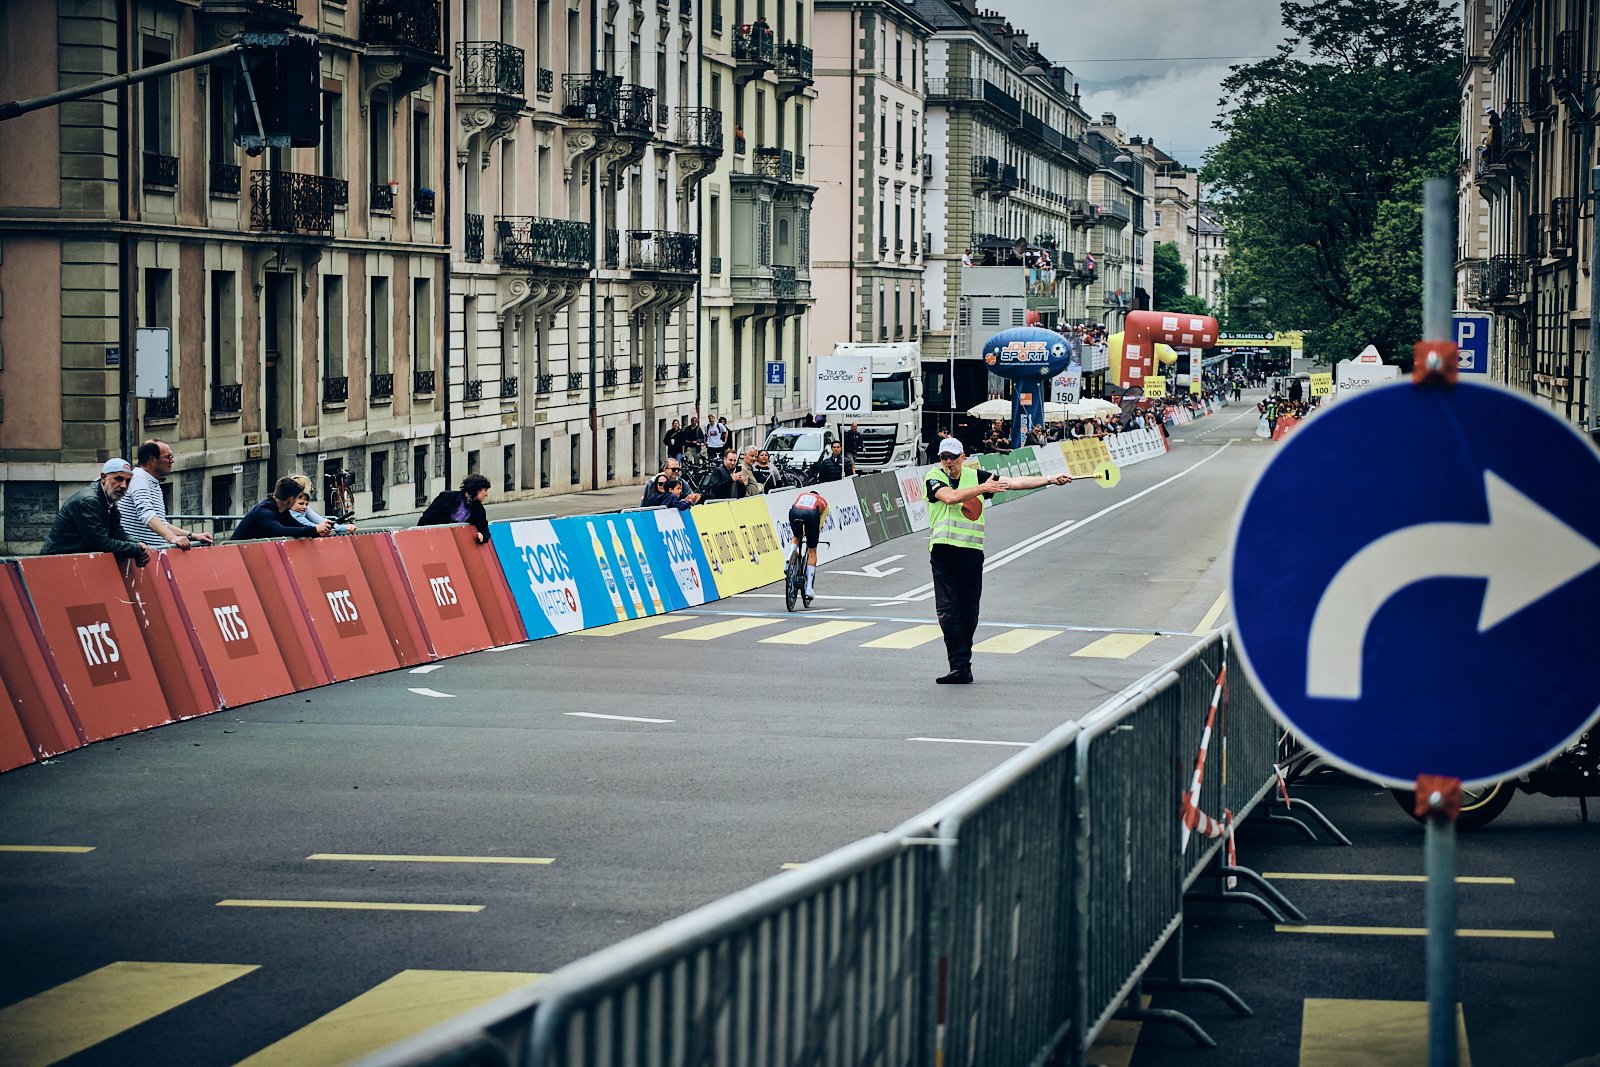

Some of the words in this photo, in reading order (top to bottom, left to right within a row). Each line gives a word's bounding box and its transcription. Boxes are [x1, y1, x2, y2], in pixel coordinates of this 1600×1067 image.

[1001, 341, 1048, 351] JOUEZ
[1457, 321, 1476, 348] P
[772, 364, 780, 375] P
[1001, 350, 1050, 362] SPORT!
[818, 373, 853, 381] Romandie
[825, 394, 861, 411] 200
[1056, 392, 1074, 403] 150
[661, 528, 697, 564] FOCUS
[519, 542, 574, 585] FOCUS
[429, 576, 458, 607] RTS
[537, 589, 571, 616] WATER
[326, 589, 360, 625] RTS
[214, 604, 249, 642] RTS
[76, 622, 122, 666] RTS
